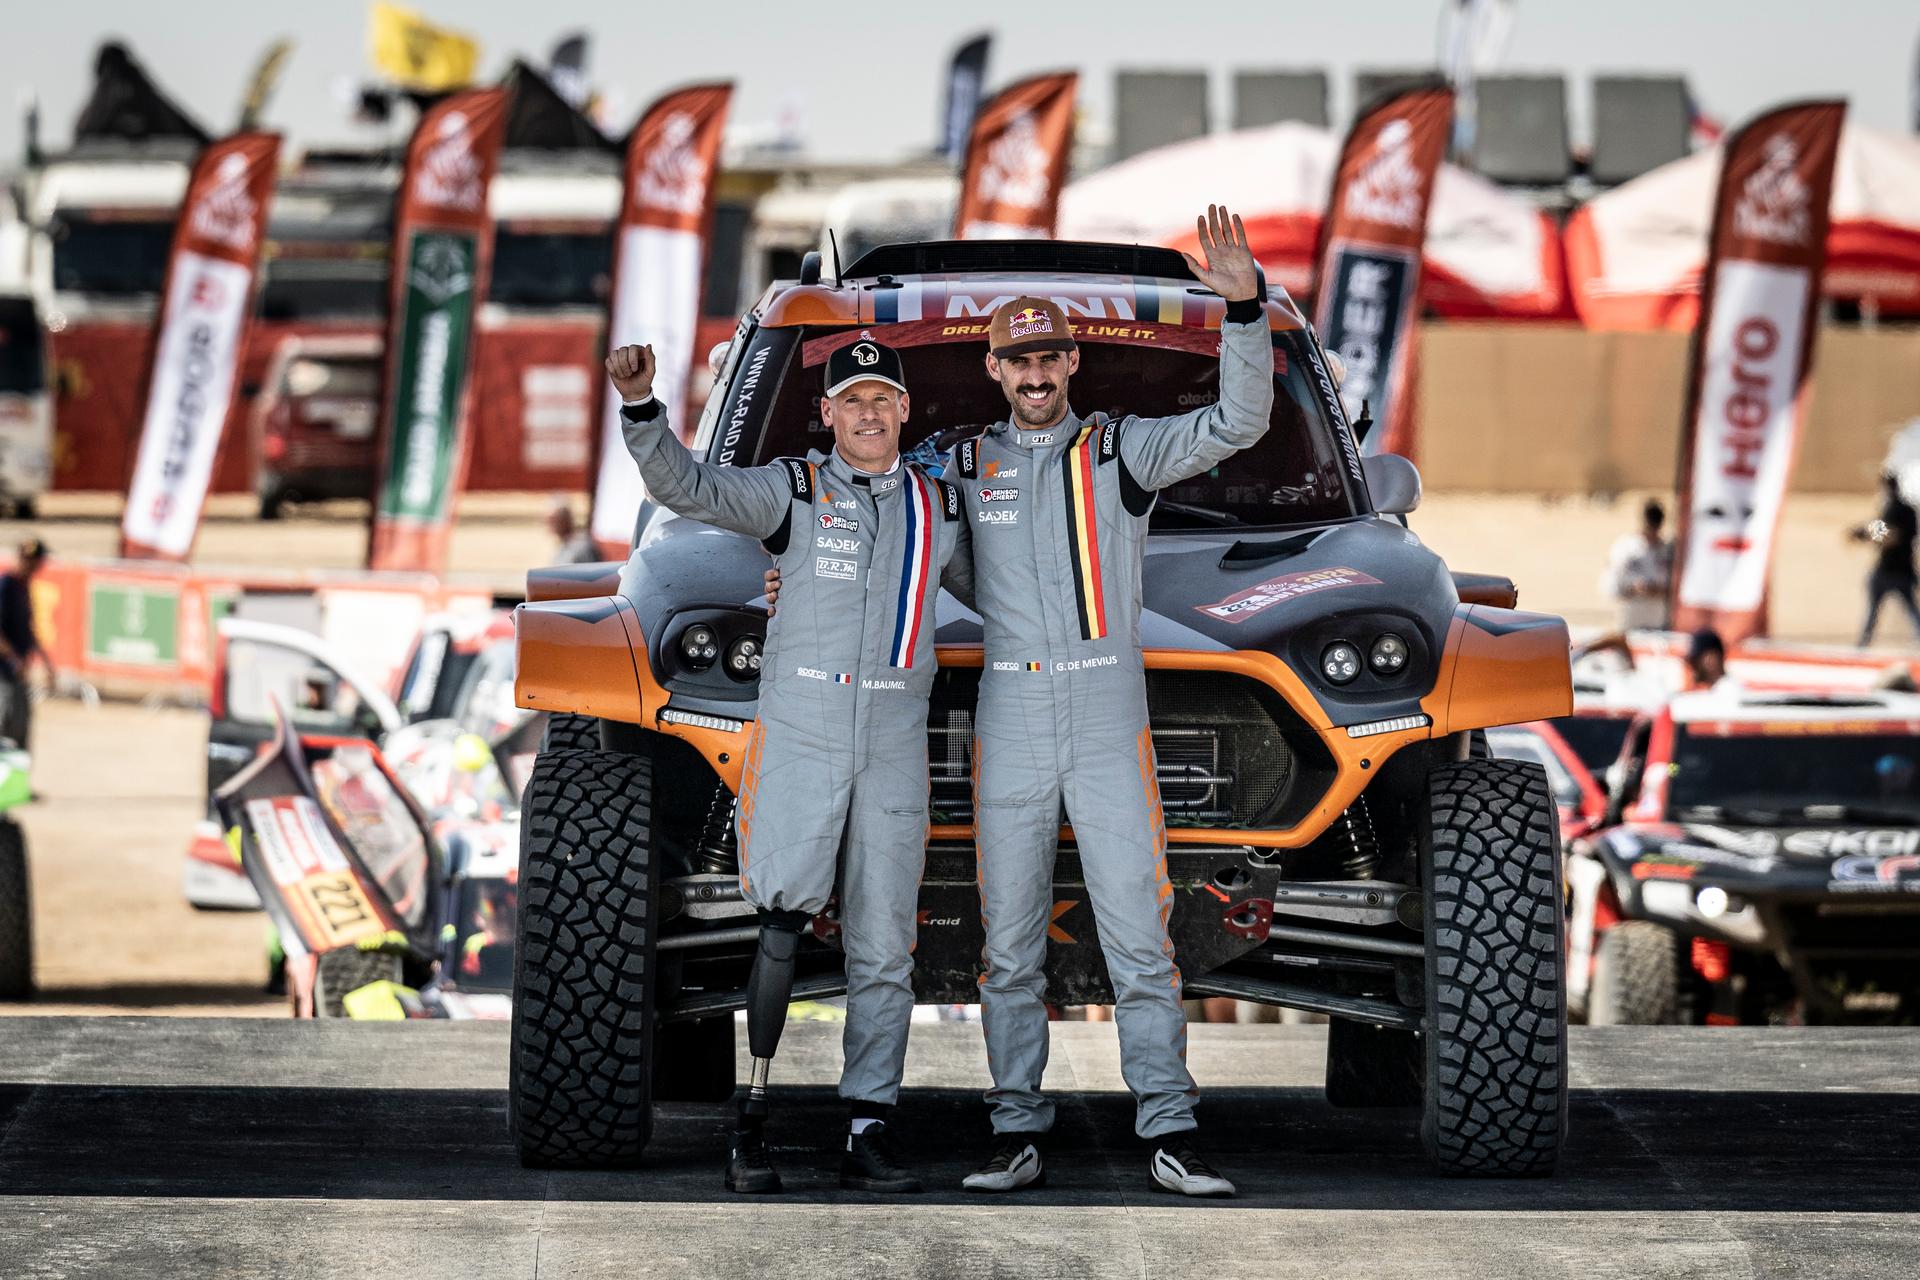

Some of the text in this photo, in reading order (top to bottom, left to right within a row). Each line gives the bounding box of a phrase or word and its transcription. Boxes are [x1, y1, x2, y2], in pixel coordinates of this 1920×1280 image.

[946, 295, 1136, 319] MNI
[942, 324, 992, 336] DREA
[1087, 325, 1131, 337] LIVE
[1134, 329, 1157, 340] IT.
[1010, 323, 1032, 338] Red
[1032, 321, 1054, 333] Bull
[1102, 422, 1117, 456] sparco
[962, 442, 974, 473] sparco
[789, 461, 807, 493] sparco
[1082, 655, 1118, 669] MEVIUS
[311, 880, 367, 931] 221
